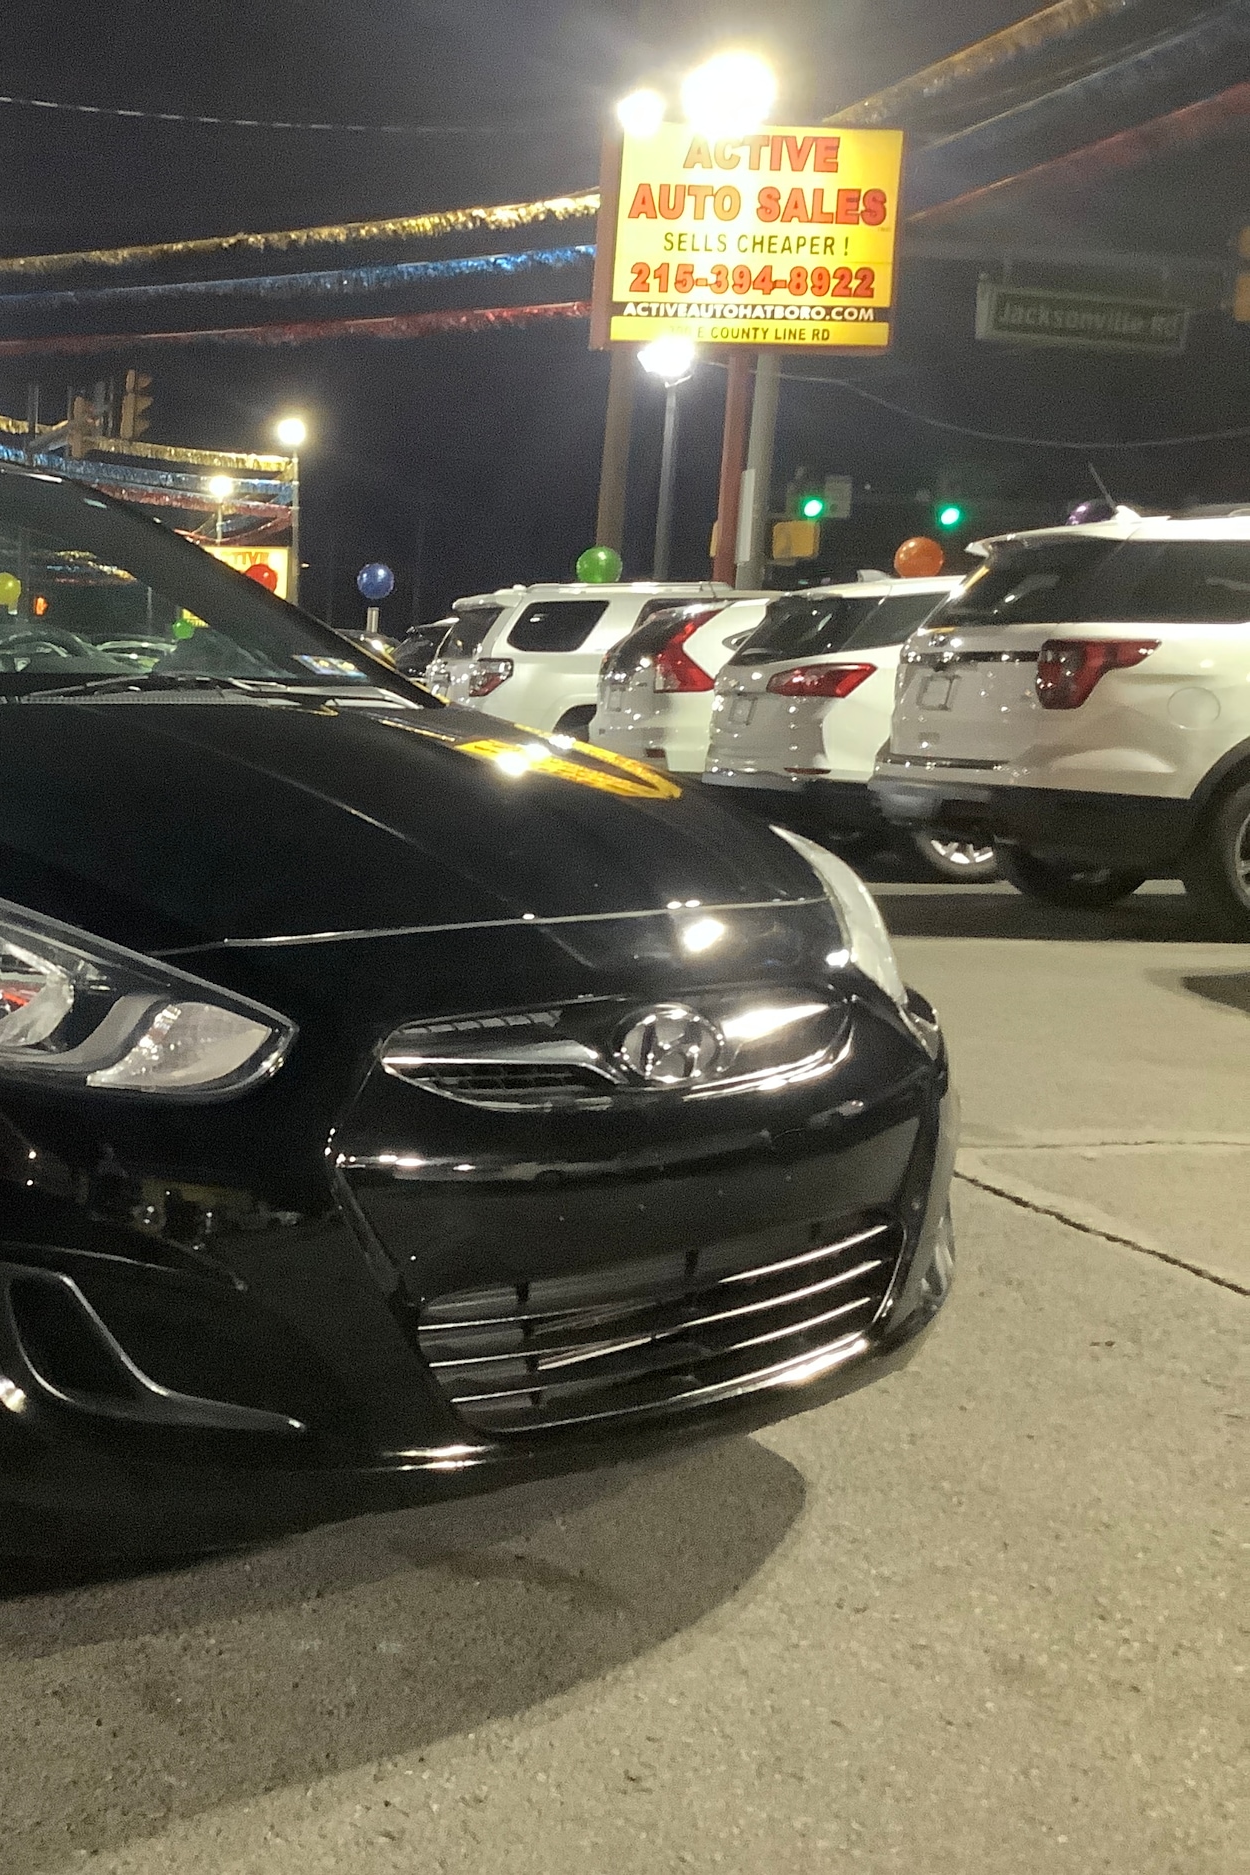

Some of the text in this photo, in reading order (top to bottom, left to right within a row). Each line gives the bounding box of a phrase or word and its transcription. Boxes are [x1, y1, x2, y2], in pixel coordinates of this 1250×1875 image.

[683, 134, 841, 173] ACTIVE
[628, 183, 887, 226] AUTO SALES
[663, 232, 727, 253] SELLS
[737, 234, 836, 256] CHEAPER
[629, 262, 875, 298] 215-394-8922
[623, 302, 875, 322] ACTIVEAUTOHATBORO.COM
[999, 302, 1144, 334] Jacksonville
[697, 326, 704, 338] E
[710, 327, 770, 340] COUNTY
[774, 327, 807, 341] LINE
[812, 328, 830, 341] RD
